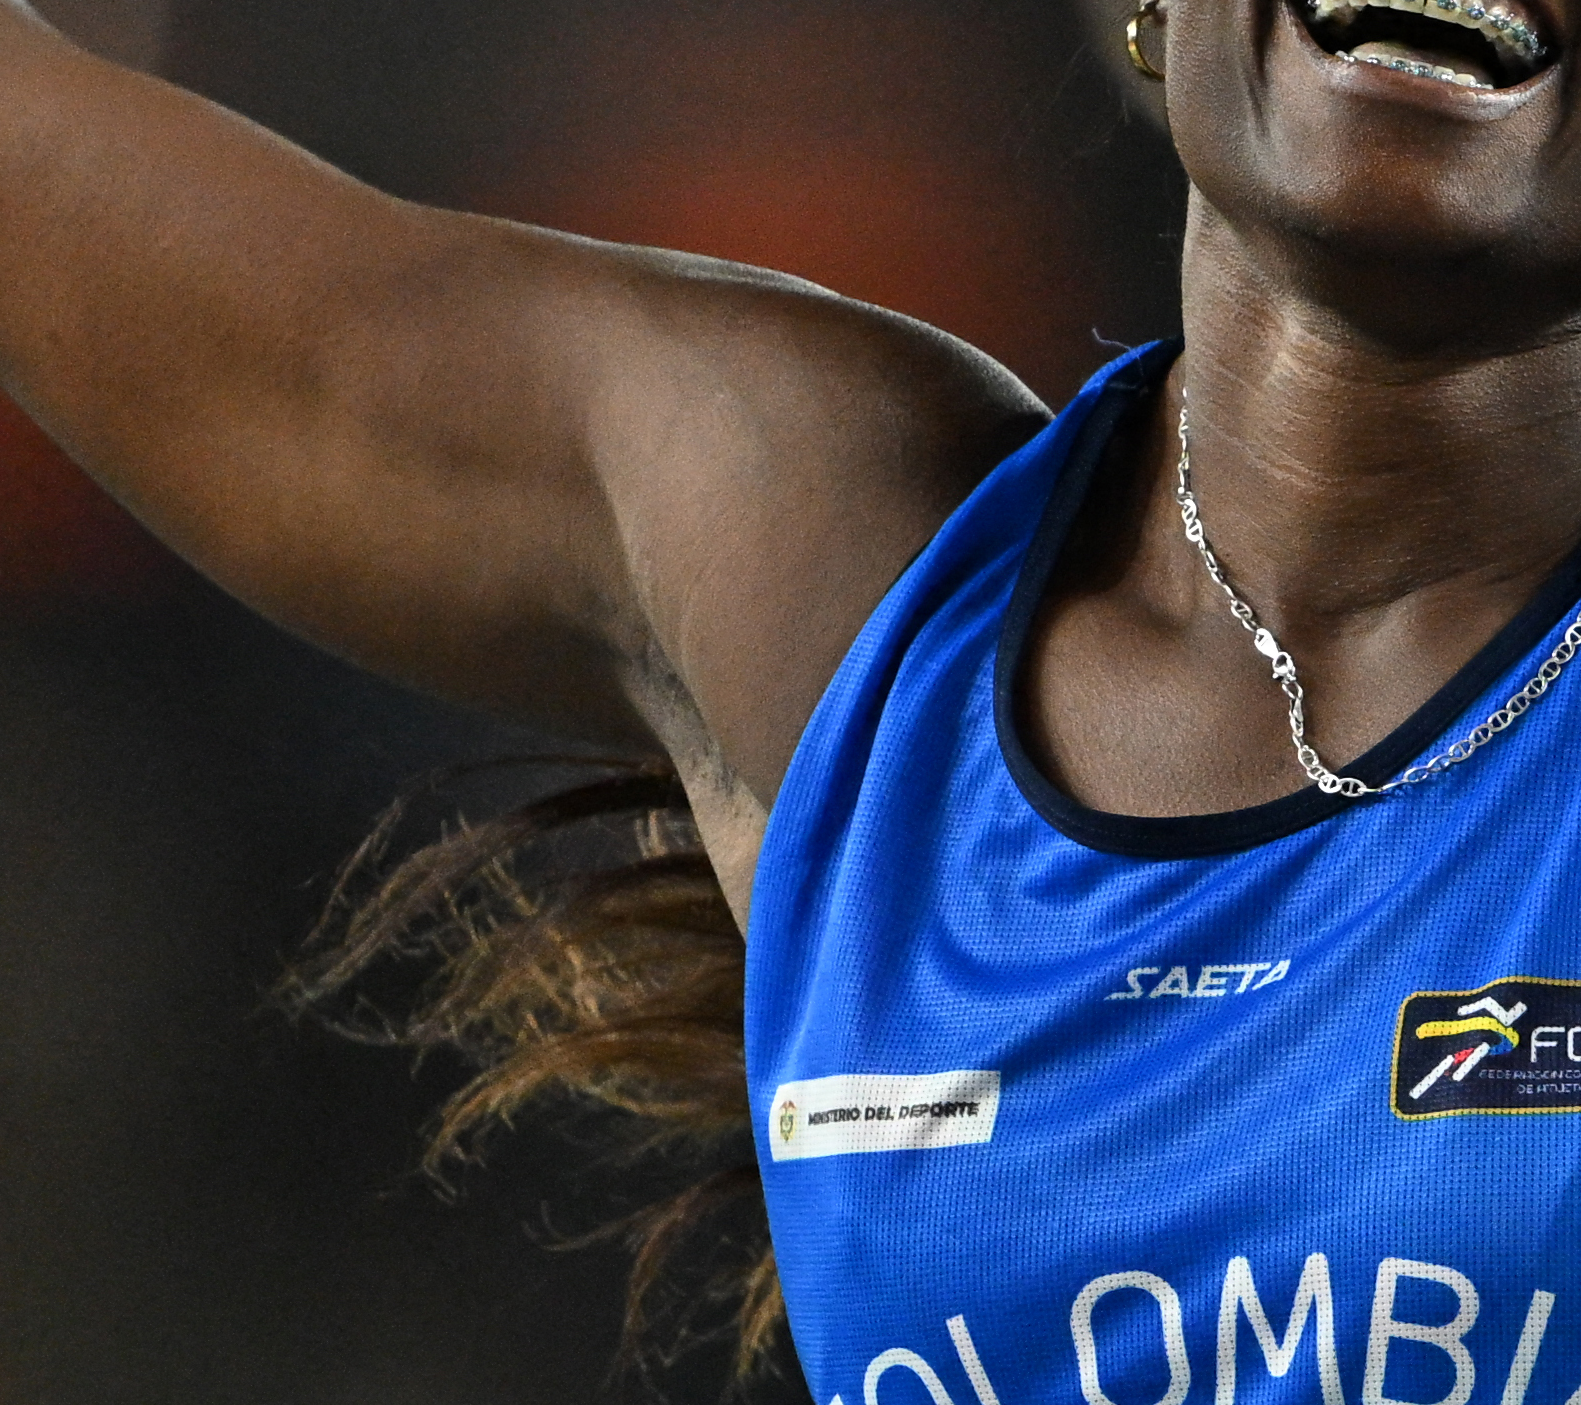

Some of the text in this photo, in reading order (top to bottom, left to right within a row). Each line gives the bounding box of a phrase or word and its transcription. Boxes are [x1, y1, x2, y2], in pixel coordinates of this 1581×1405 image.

[1104, 959, 1291, 1001] SAETA
[864, 1105, 894, 1121] DEL
[898, 1101, 981, 1119] DEPORTE
